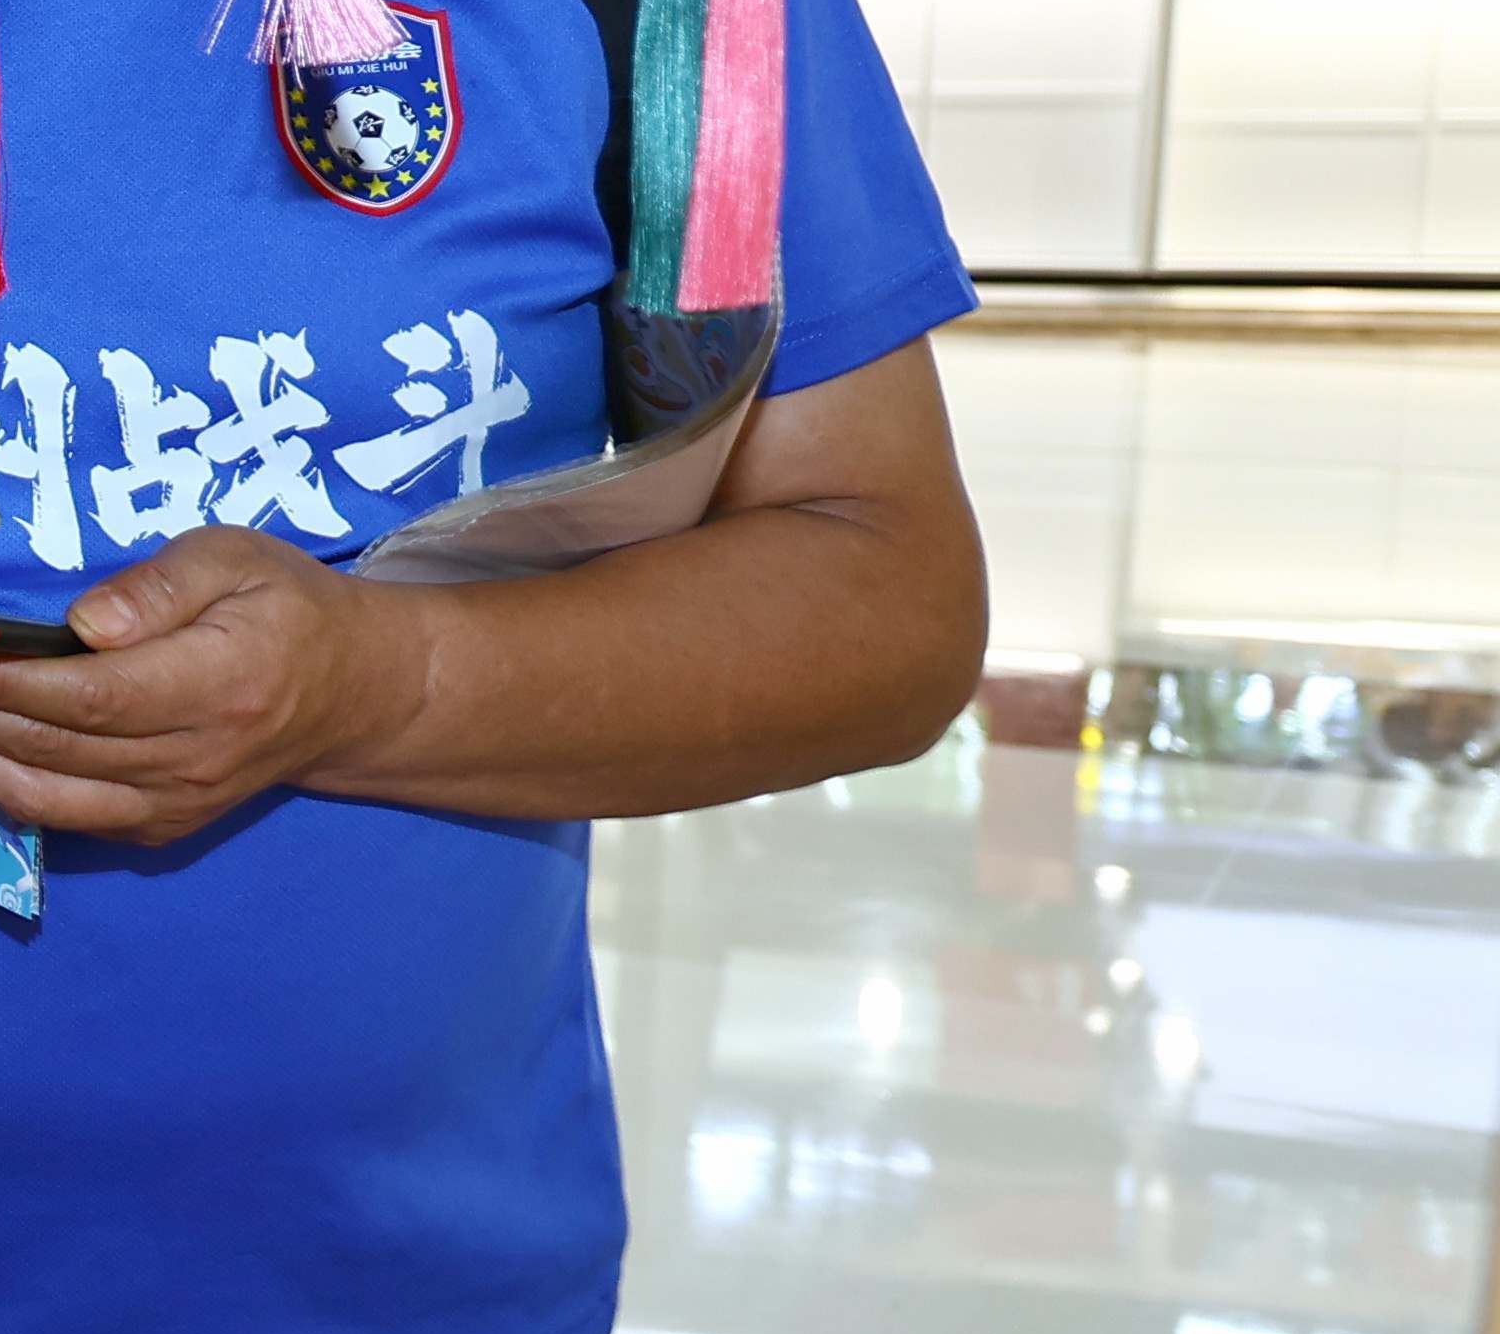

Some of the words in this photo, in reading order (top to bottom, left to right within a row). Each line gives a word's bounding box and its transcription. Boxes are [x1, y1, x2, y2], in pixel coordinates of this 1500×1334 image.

[310, 66, 335, 77] QIU
[337, 65, 354, 76] MI
[357, 63, 381, 74] XIE
[383, 61, 408, 72] HUI
